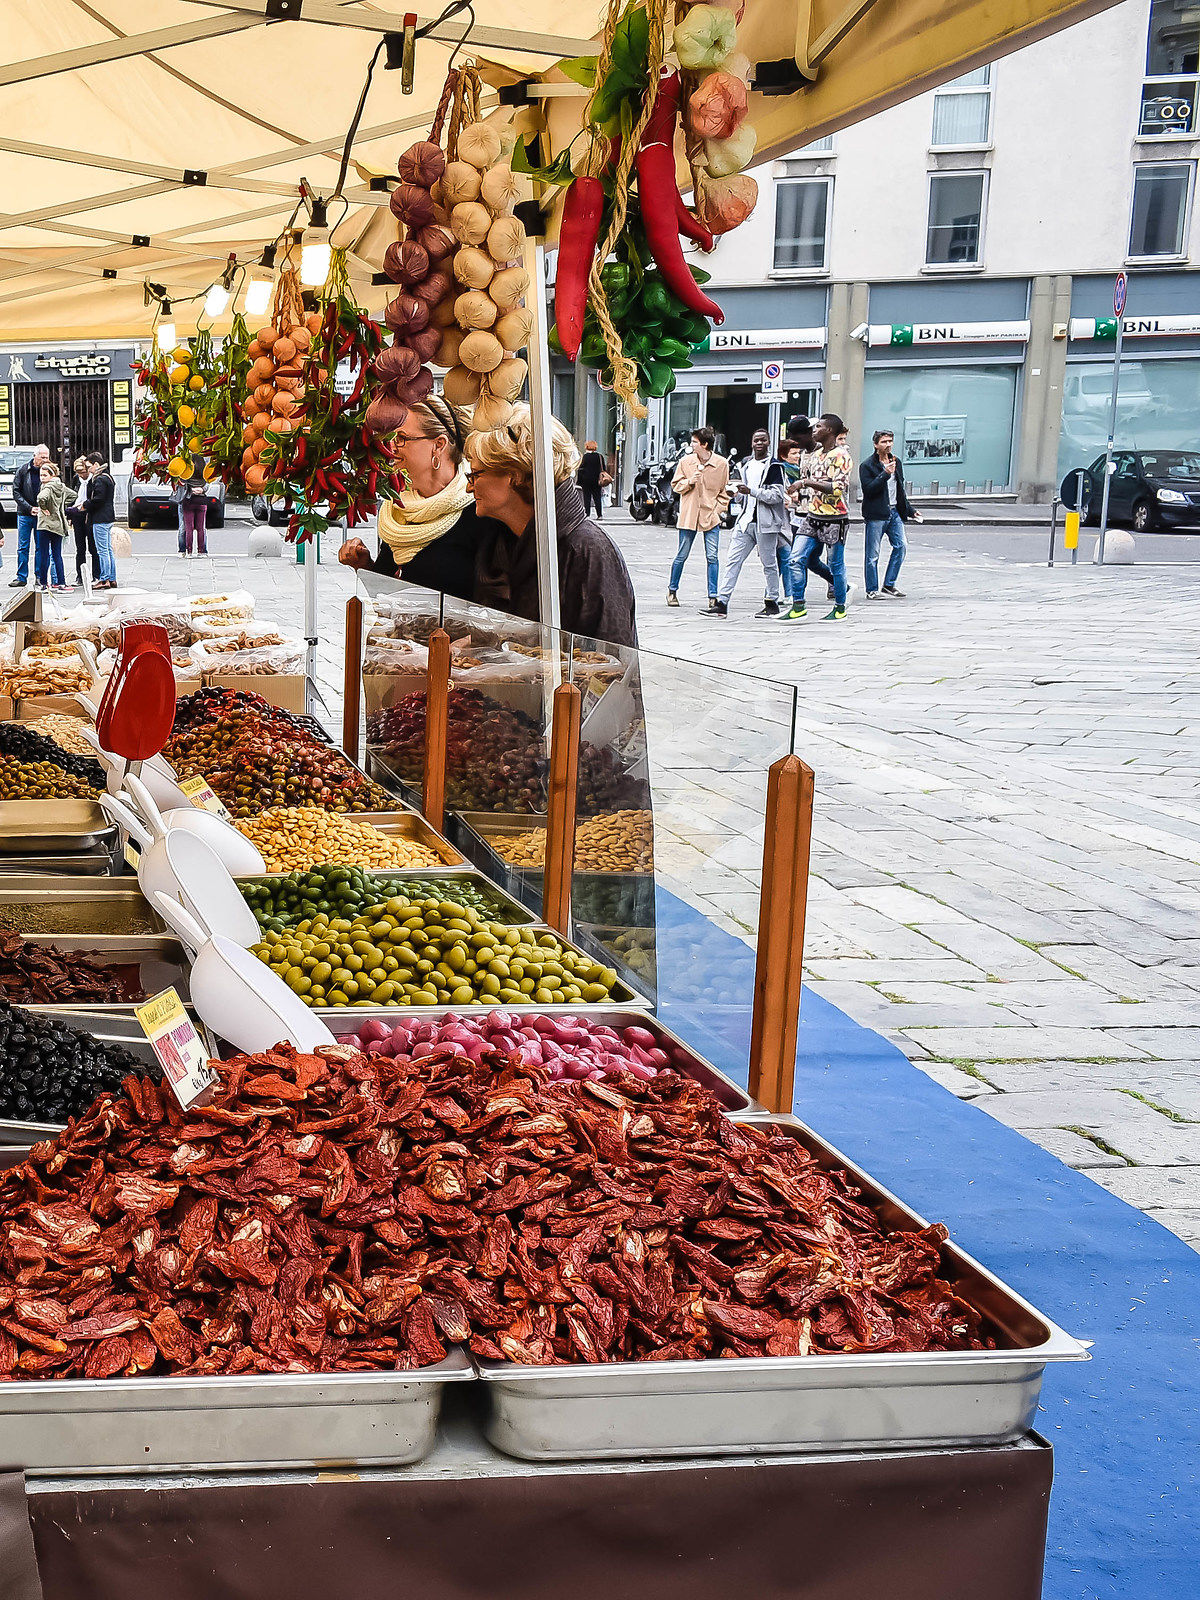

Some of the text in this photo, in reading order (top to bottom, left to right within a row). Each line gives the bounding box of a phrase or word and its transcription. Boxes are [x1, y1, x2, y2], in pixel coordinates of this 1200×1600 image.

[1122, 320, 1165, 333] BNL
[918, 327, 961, 340] BNL
[715, 335, 756, 347] BNL
[34, 355, 111, 369] studio
[59, 365, 111, 377] uno
